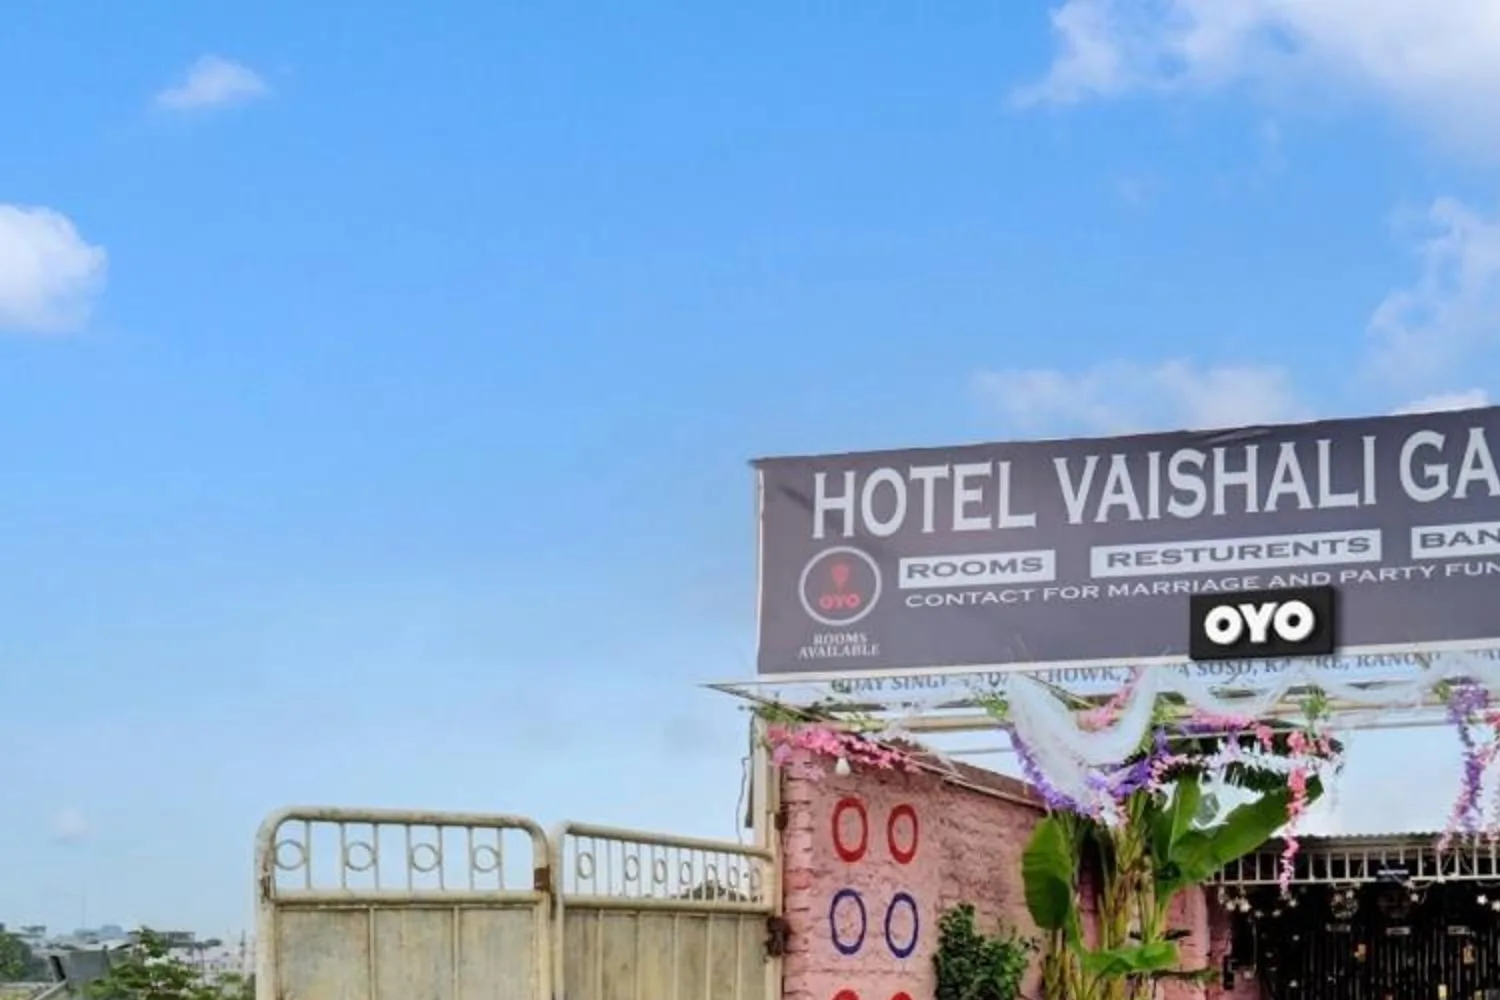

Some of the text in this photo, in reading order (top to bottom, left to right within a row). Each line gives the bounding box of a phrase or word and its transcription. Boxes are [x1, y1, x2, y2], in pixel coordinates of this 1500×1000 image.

[812, 460, 1037, 539] HOTEL
[1053, 435, 1378, 525] VAISHALI
[1106, 537, 1371, 569] RESTURENTS
[906, 557, 1044, 579] ROOMS
[905, 588, 1036, 608] CONTACT
[1043, 585, 1099, 601] FOR
[1107, 574, 1261, 598] MARRIAGE
[1268, 570, 1331, 590] AND
[1339, 564, 1435, 584] PARTY
[819, 593, 861, 610] OYO
[1203, 600, 1316, 646] OYO
[798, 643, 880, 660] AVAILABLE
[813, 631, 868, 646] ROOMS
